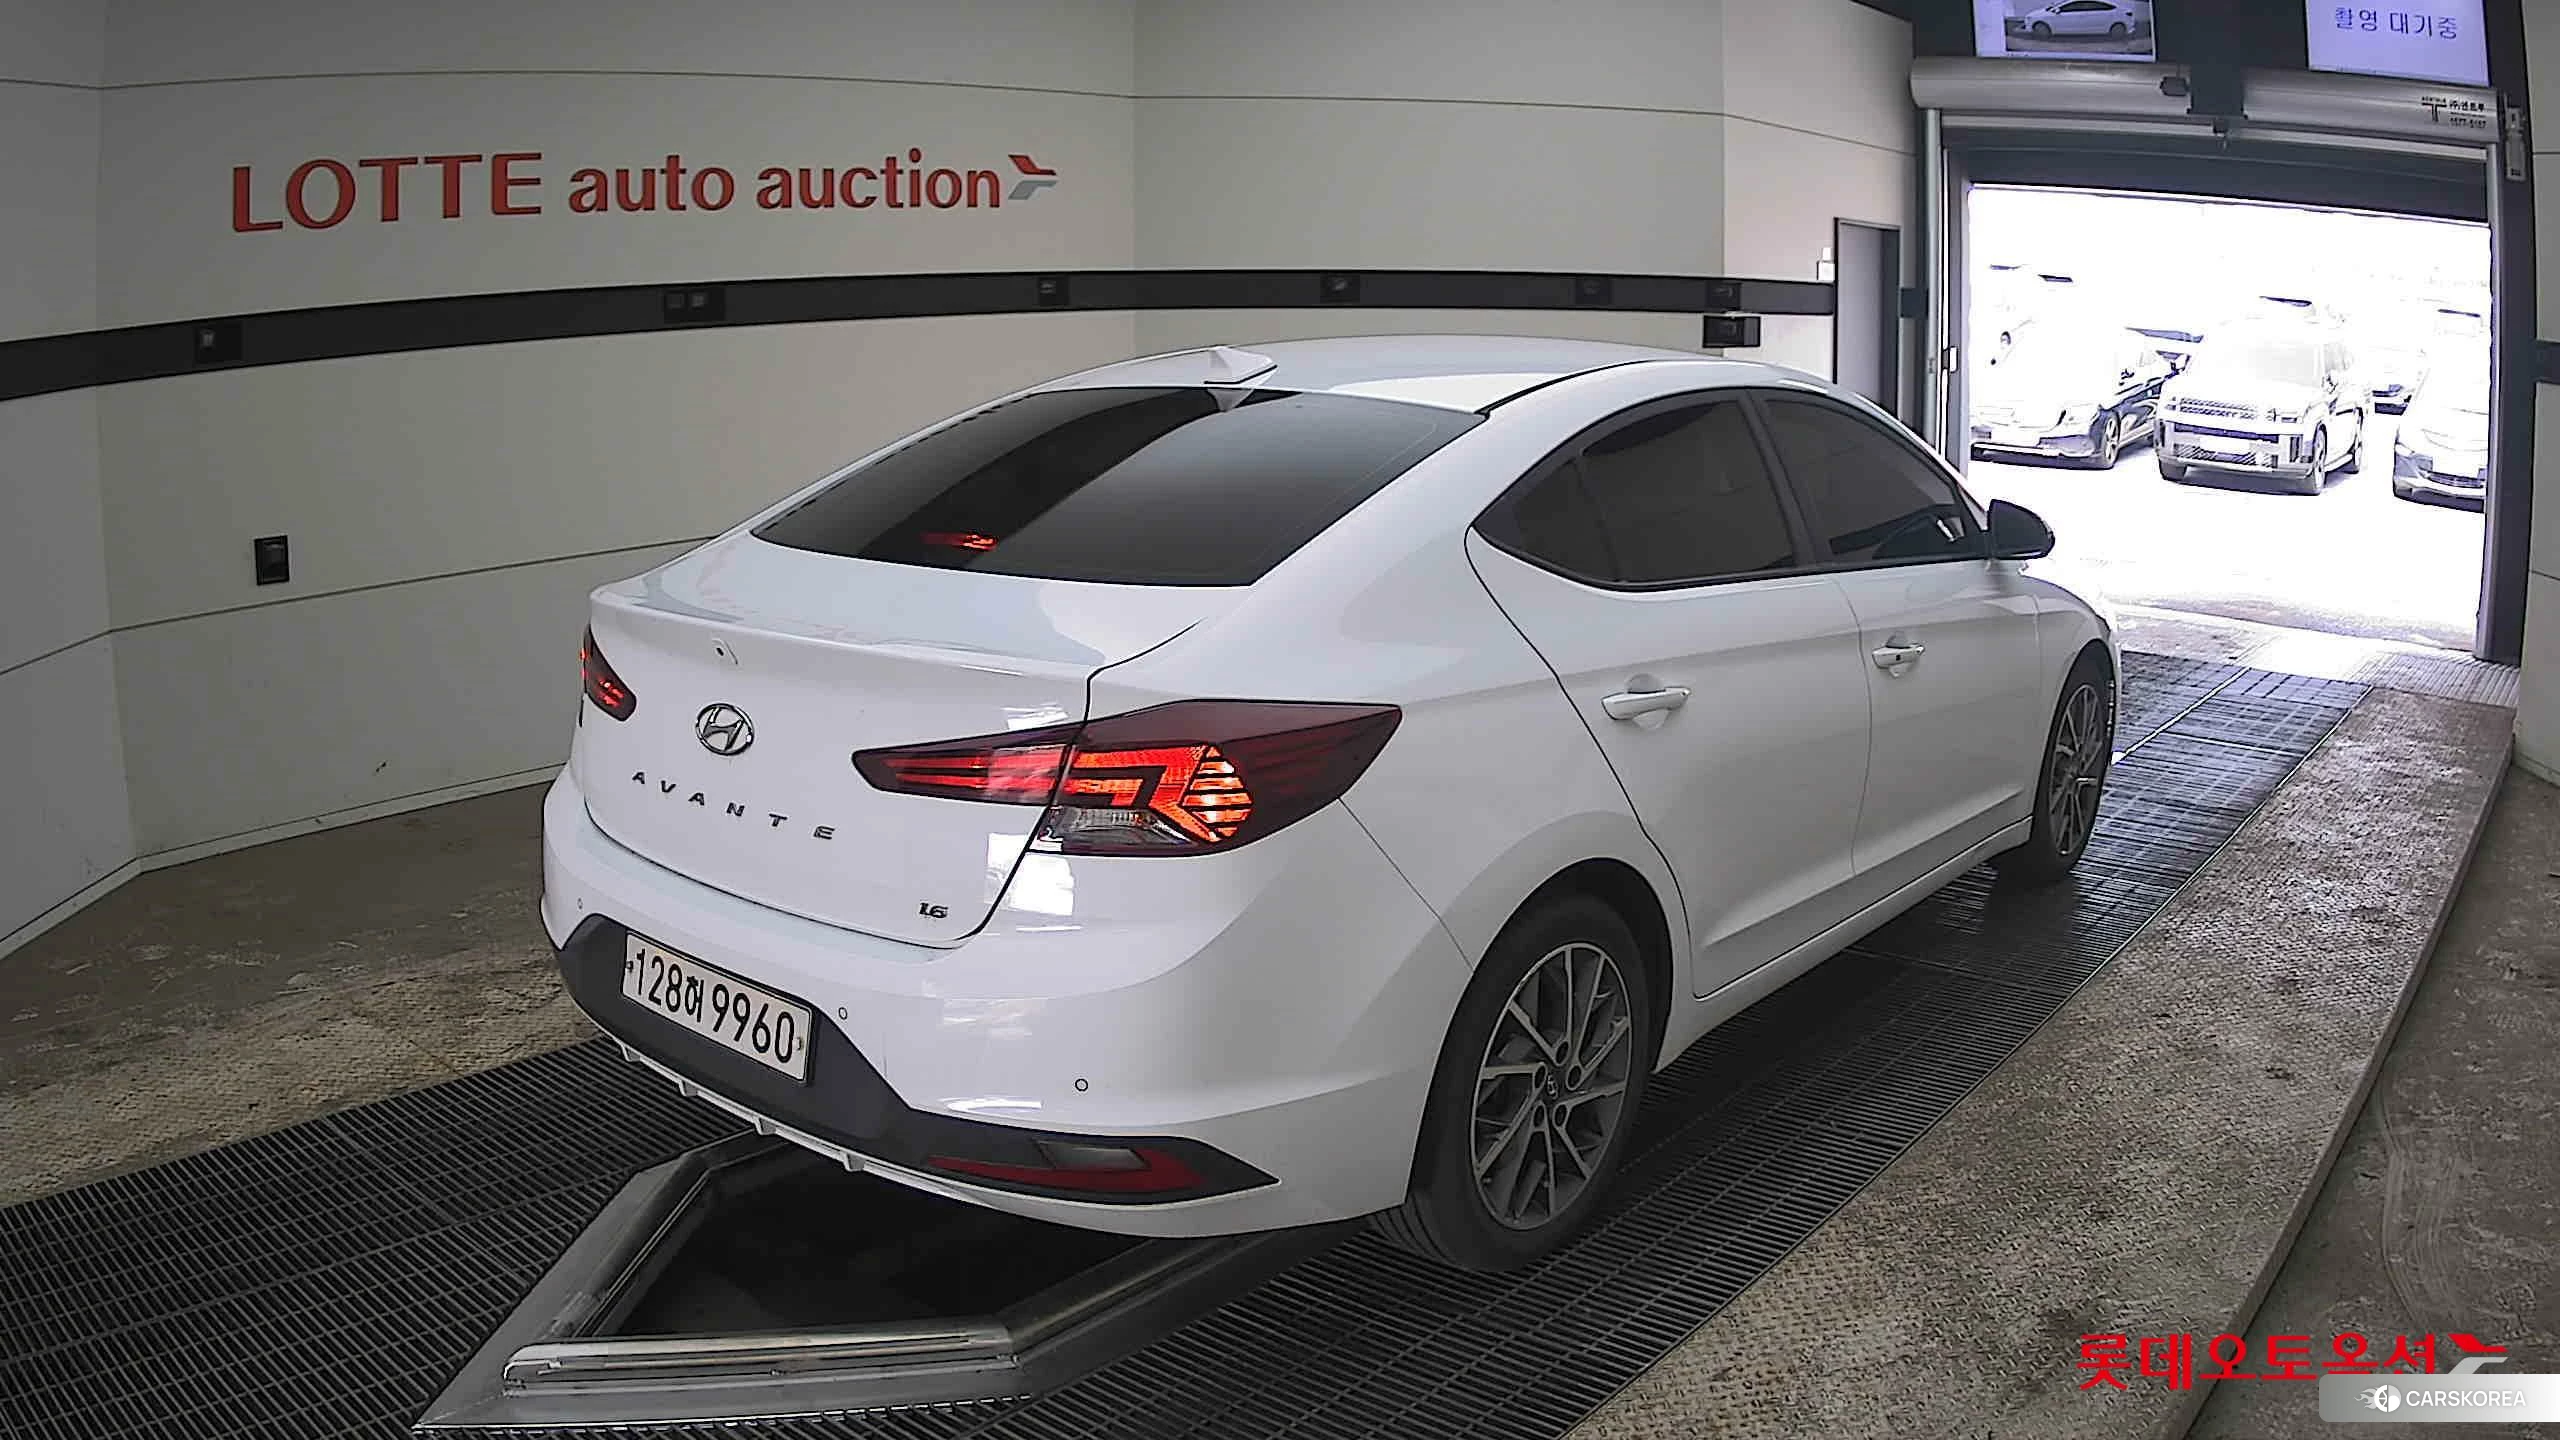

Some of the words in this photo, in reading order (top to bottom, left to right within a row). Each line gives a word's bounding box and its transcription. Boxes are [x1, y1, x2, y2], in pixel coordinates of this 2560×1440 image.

[2335, 7, 2378, 32] 촬영
[2389, 11, 2458, 40] 대기중
[233, 152, 543, 233] LOTTE
[568, 154, 735, 213] auto
[755, 148, 1003, 210] auction
[631, 771, 837, 841] AVANTE
